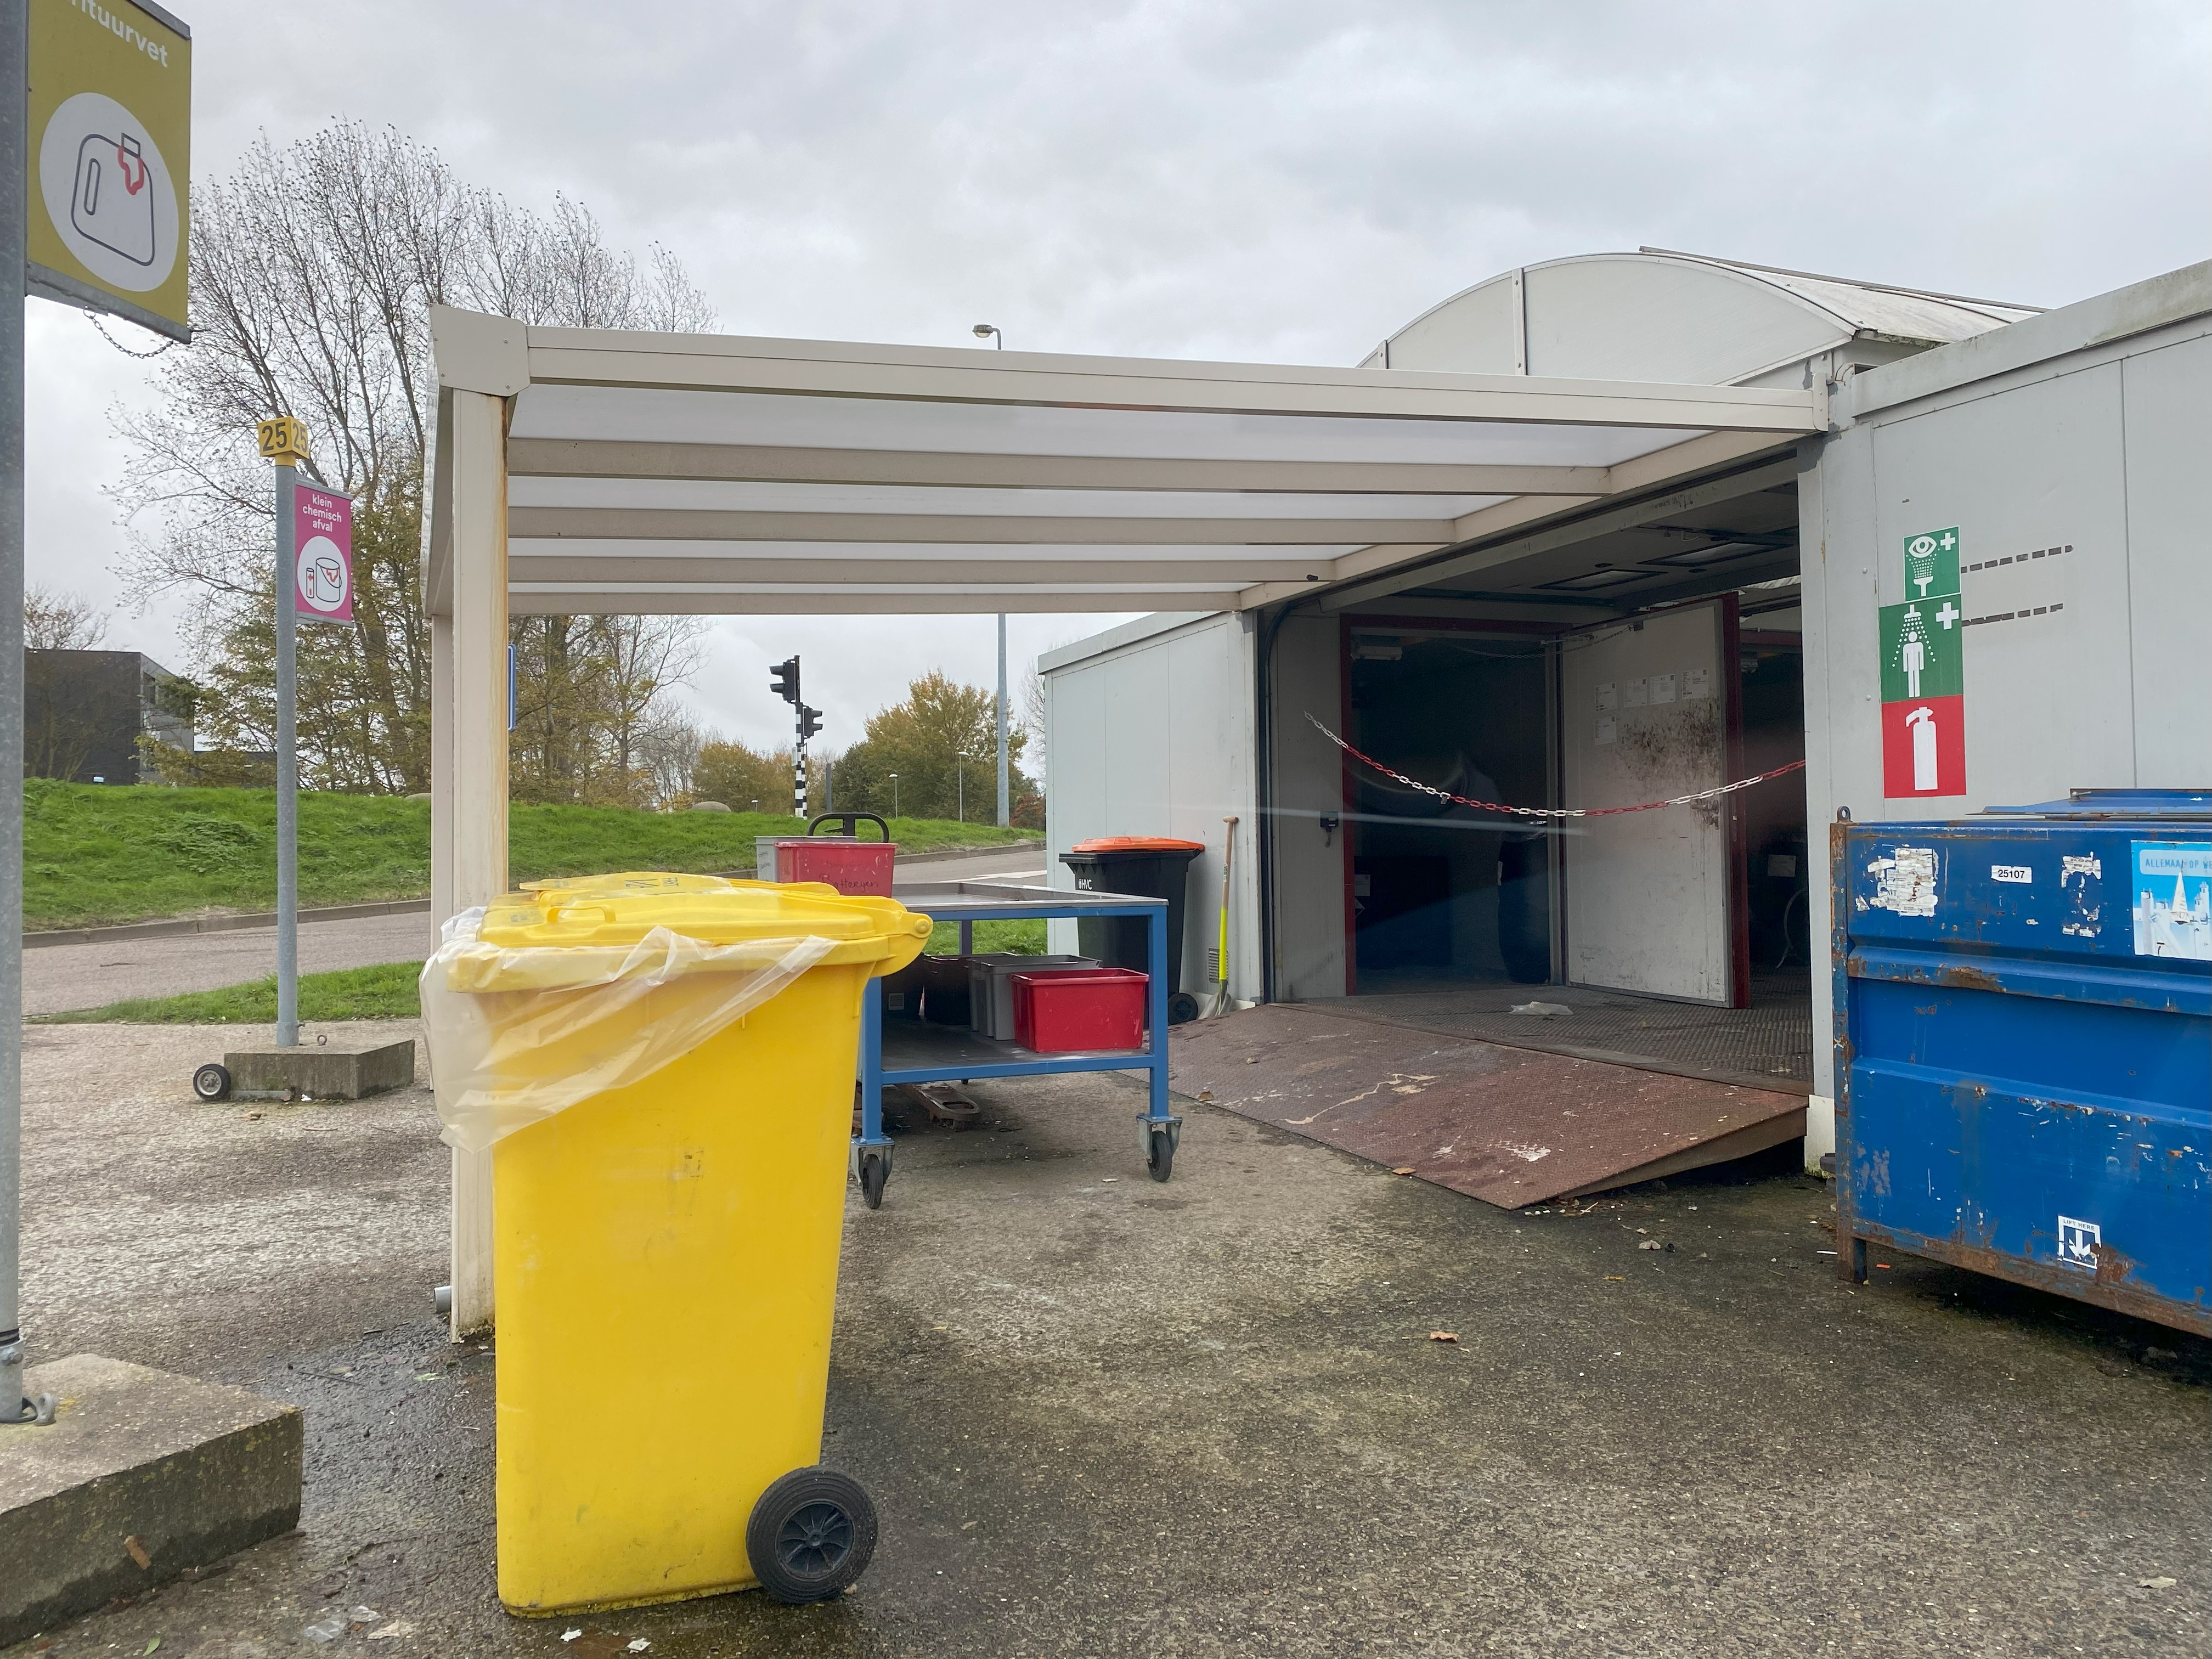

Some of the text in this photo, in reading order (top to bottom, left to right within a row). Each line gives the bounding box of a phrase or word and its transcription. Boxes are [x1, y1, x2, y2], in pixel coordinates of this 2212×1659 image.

[262, 422, 287, 452] 25
[292, 422, 307, 453] 25
[312, 493, 332, 509] klein
[302, 504, 342, 523] chemisch
[312, 518, 333, 533] afval
[2189, 860, 2199, 868] OP
[1997, 869, 2025, 879] 25107
[1081, 879, 1092, 890] HVC
[2078, 1222, 2095, 1231] HERE
